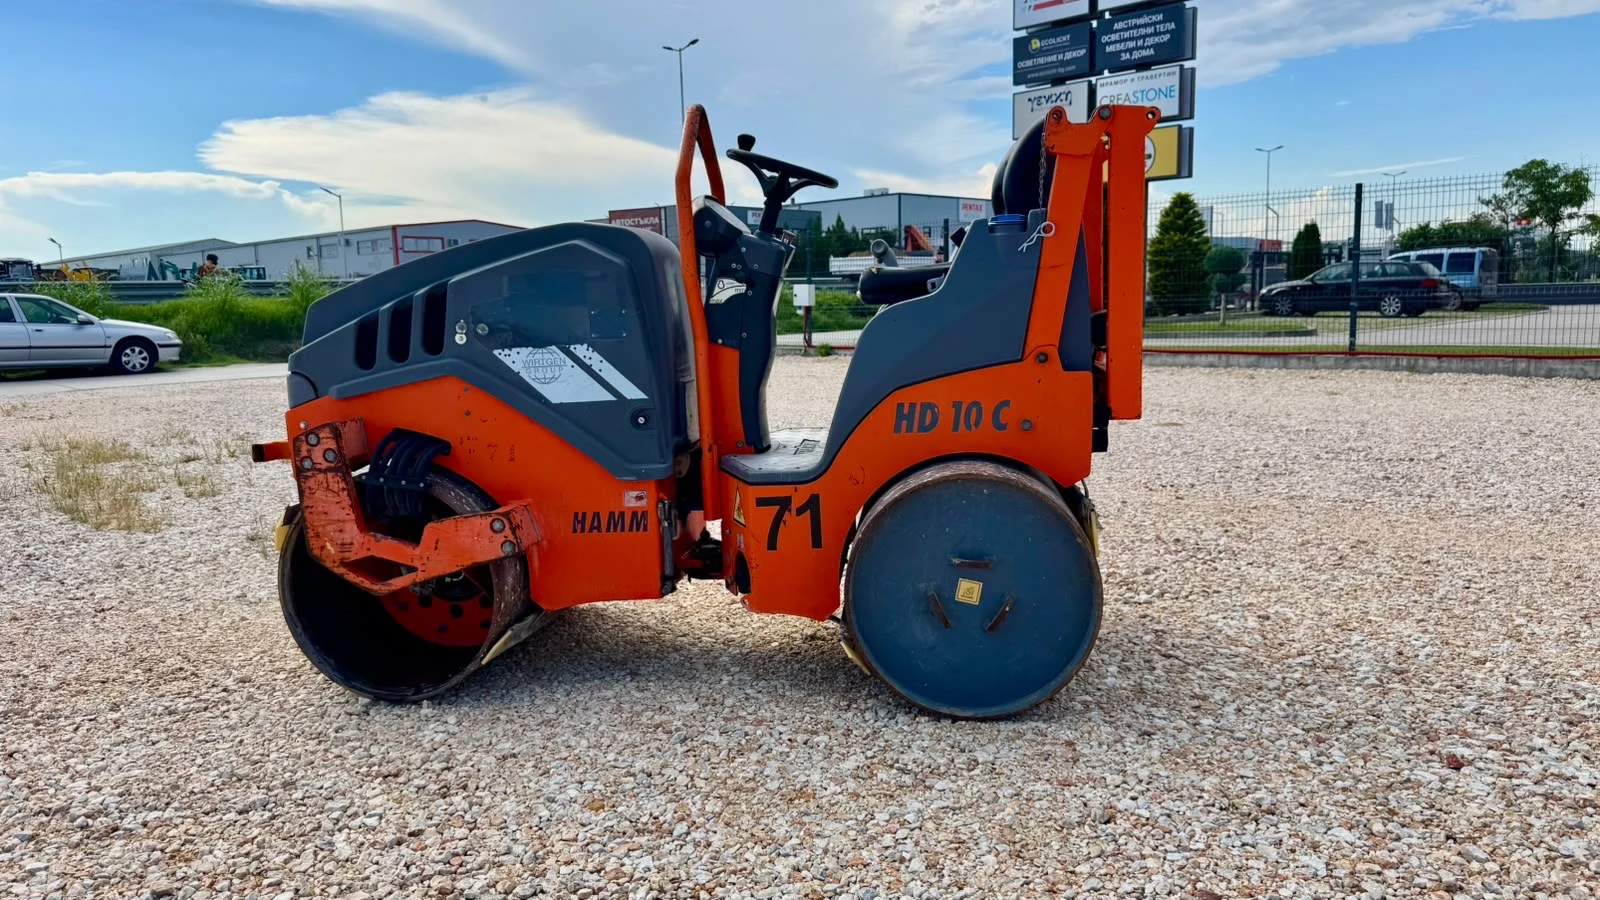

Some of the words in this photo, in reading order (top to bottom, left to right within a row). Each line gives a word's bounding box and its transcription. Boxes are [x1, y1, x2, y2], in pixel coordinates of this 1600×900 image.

[1113, 13, 1164, 30] АВСТРИЙСКИ
[1101, 26, 1154, 43] ОСВЕТИТЕЛНИ
[1155, 21, 1176, 33] ТЕЛА
[1105, 40, 1136, 53] МЕБЕЛИ
[1137, 38, 1144, 47] И
[1144, 33, 1171, 48] ДЕКОР
[1063, 48, 1087, 61] ДЕКОР
[1120, 52, 1131, 61] ЗА
[1131, 47, 1155, 60] ДОМА
[1099, 78, 1128, 88] МРАМОР
[1137, 70, 1177, 81] ТРАВЕРТИН
[1099, 84, 1176, 105] CREASTONE
[610, 216, 659, 226] АВТОСТЪКЛА
[522, 357, 567, 368] WIRTGEN
[525, 366, 564, 374] GROUP
[893, 401, 940, 434] HD
[951, 400, 983, 433] 10
[991, 399, 1011, 432] C
[572, 510, 648, 534] HAMM
[755, 493, 823, 551] 71
